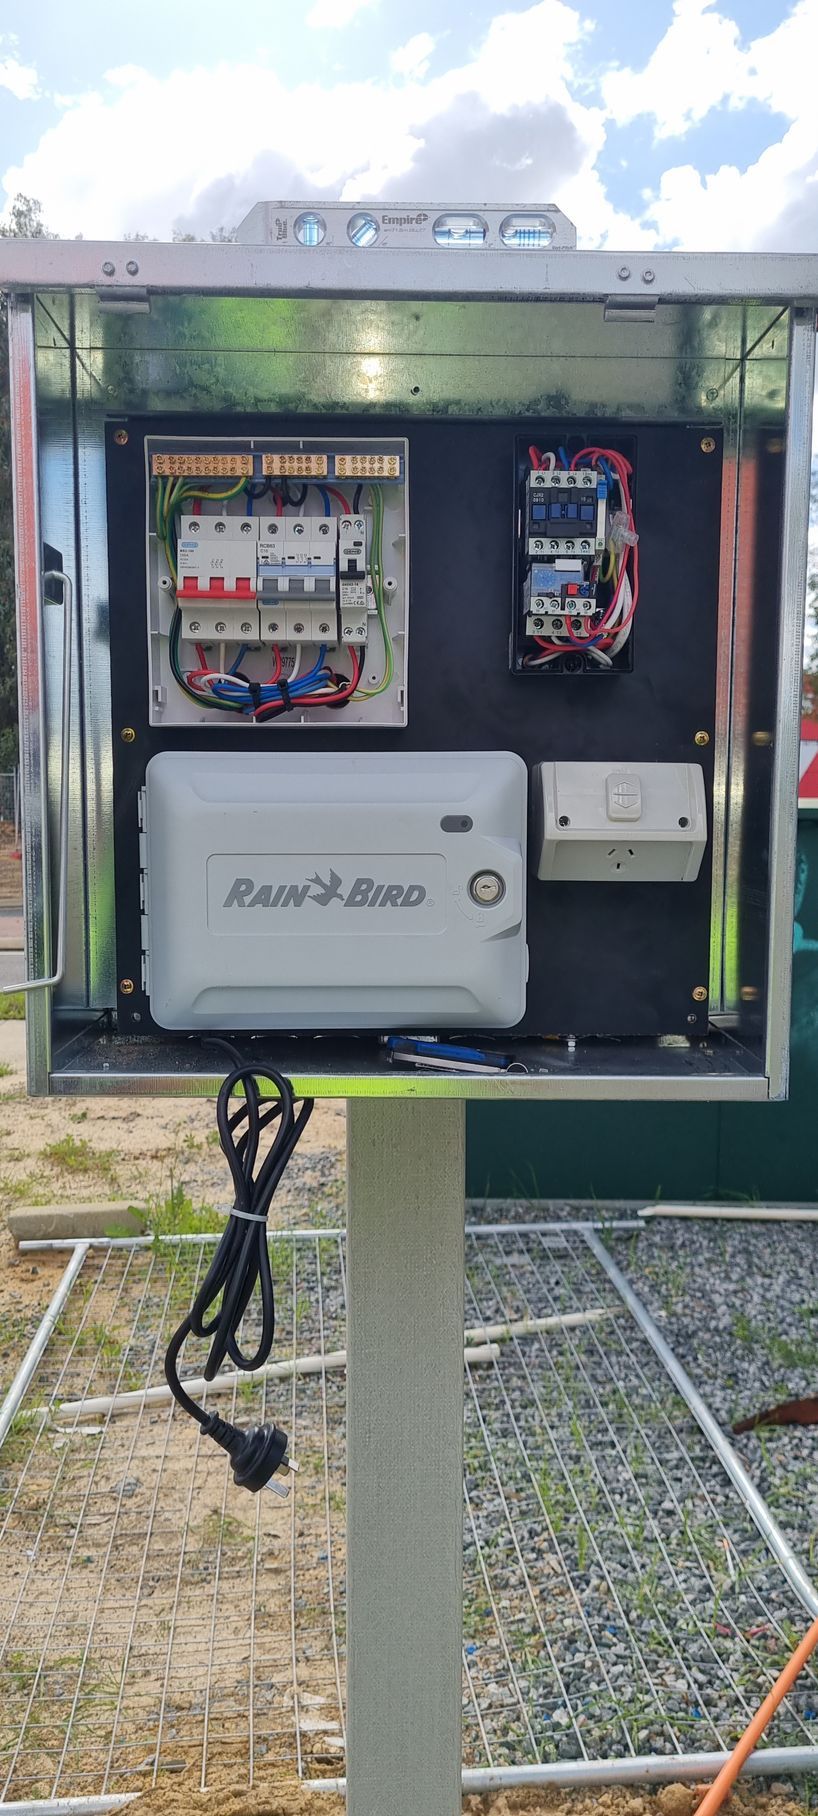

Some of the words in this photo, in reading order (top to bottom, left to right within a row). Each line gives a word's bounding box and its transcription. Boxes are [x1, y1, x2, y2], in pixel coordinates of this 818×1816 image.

[381, 214, 422, 227] Empire
[222, 877, 311, 908] RAIN
[343, 877, 427, 908] BIRD
